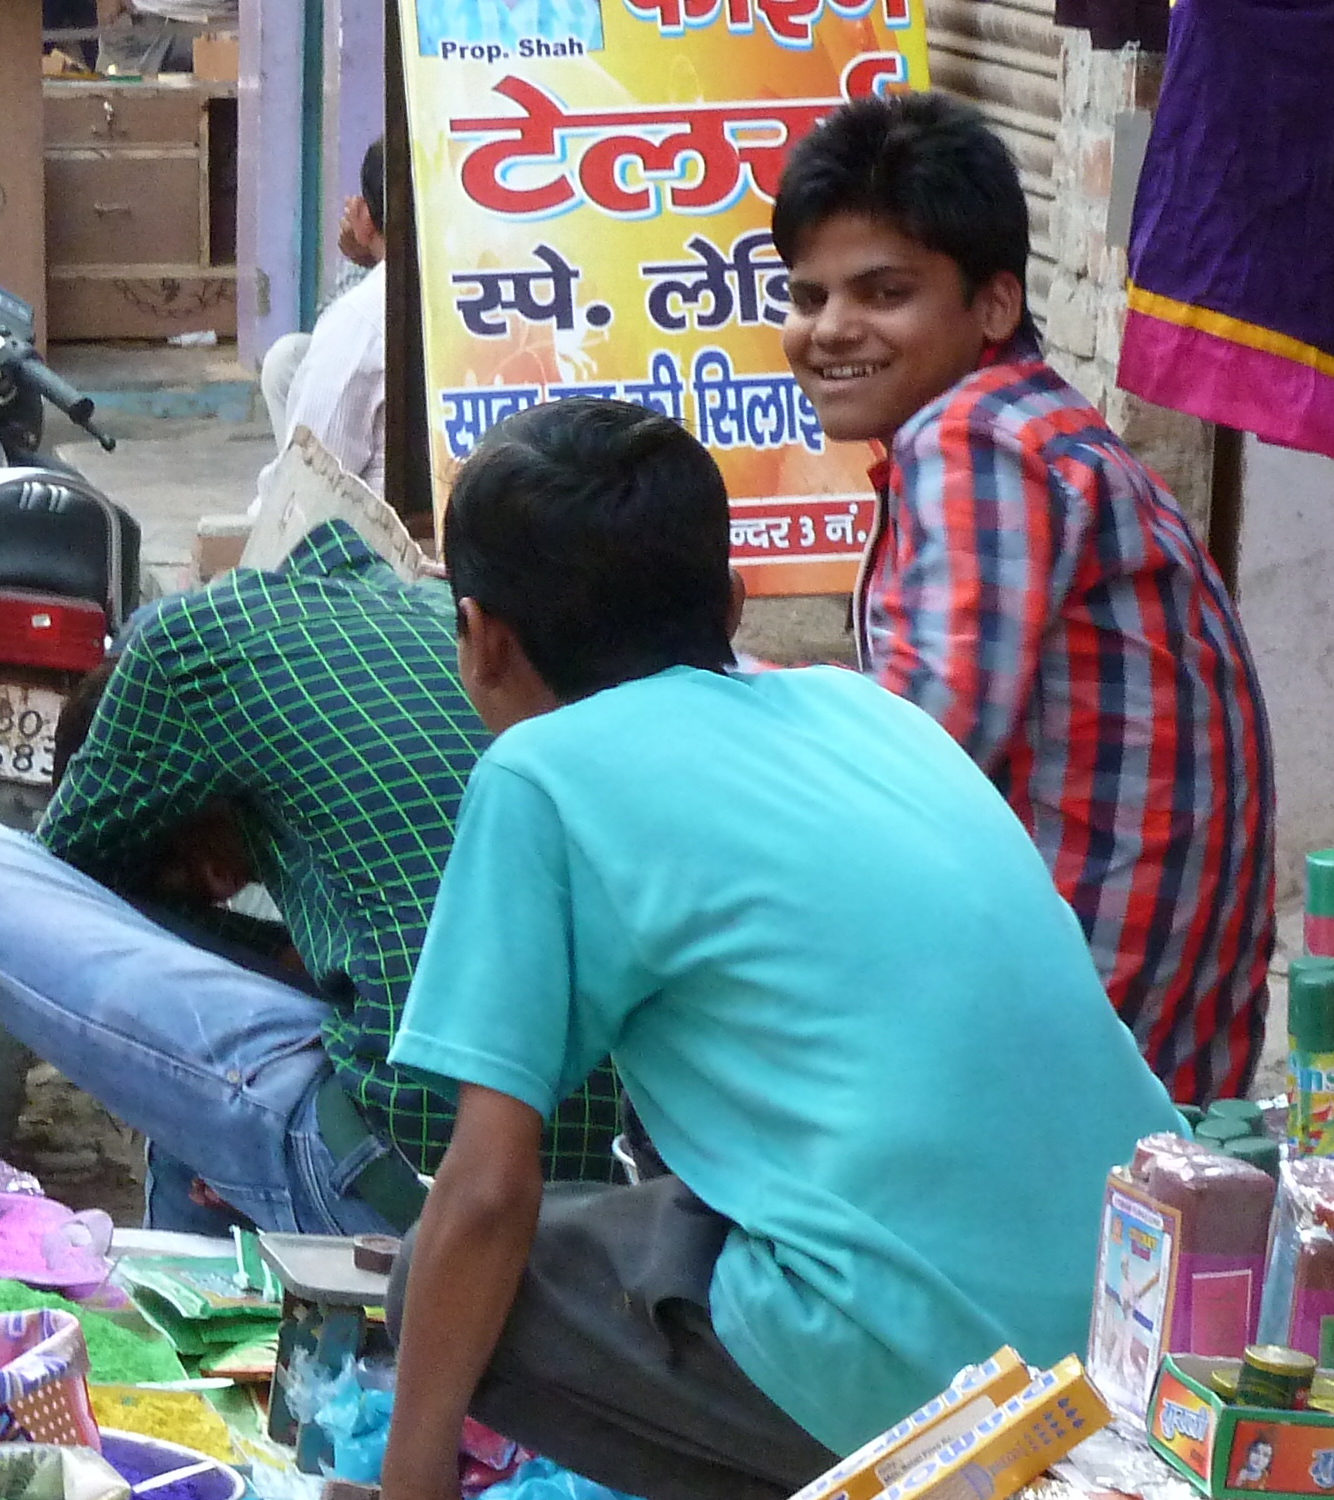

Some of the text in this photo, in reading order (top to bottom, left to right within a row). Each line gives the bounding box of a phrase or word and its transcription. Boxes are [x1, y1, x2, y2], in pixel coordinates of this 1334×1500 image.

[441, 36, 584, 63] Prop. Shah
[452, 244, 613, 334] स्पे.
[824, 502, 867, 546] नं.
